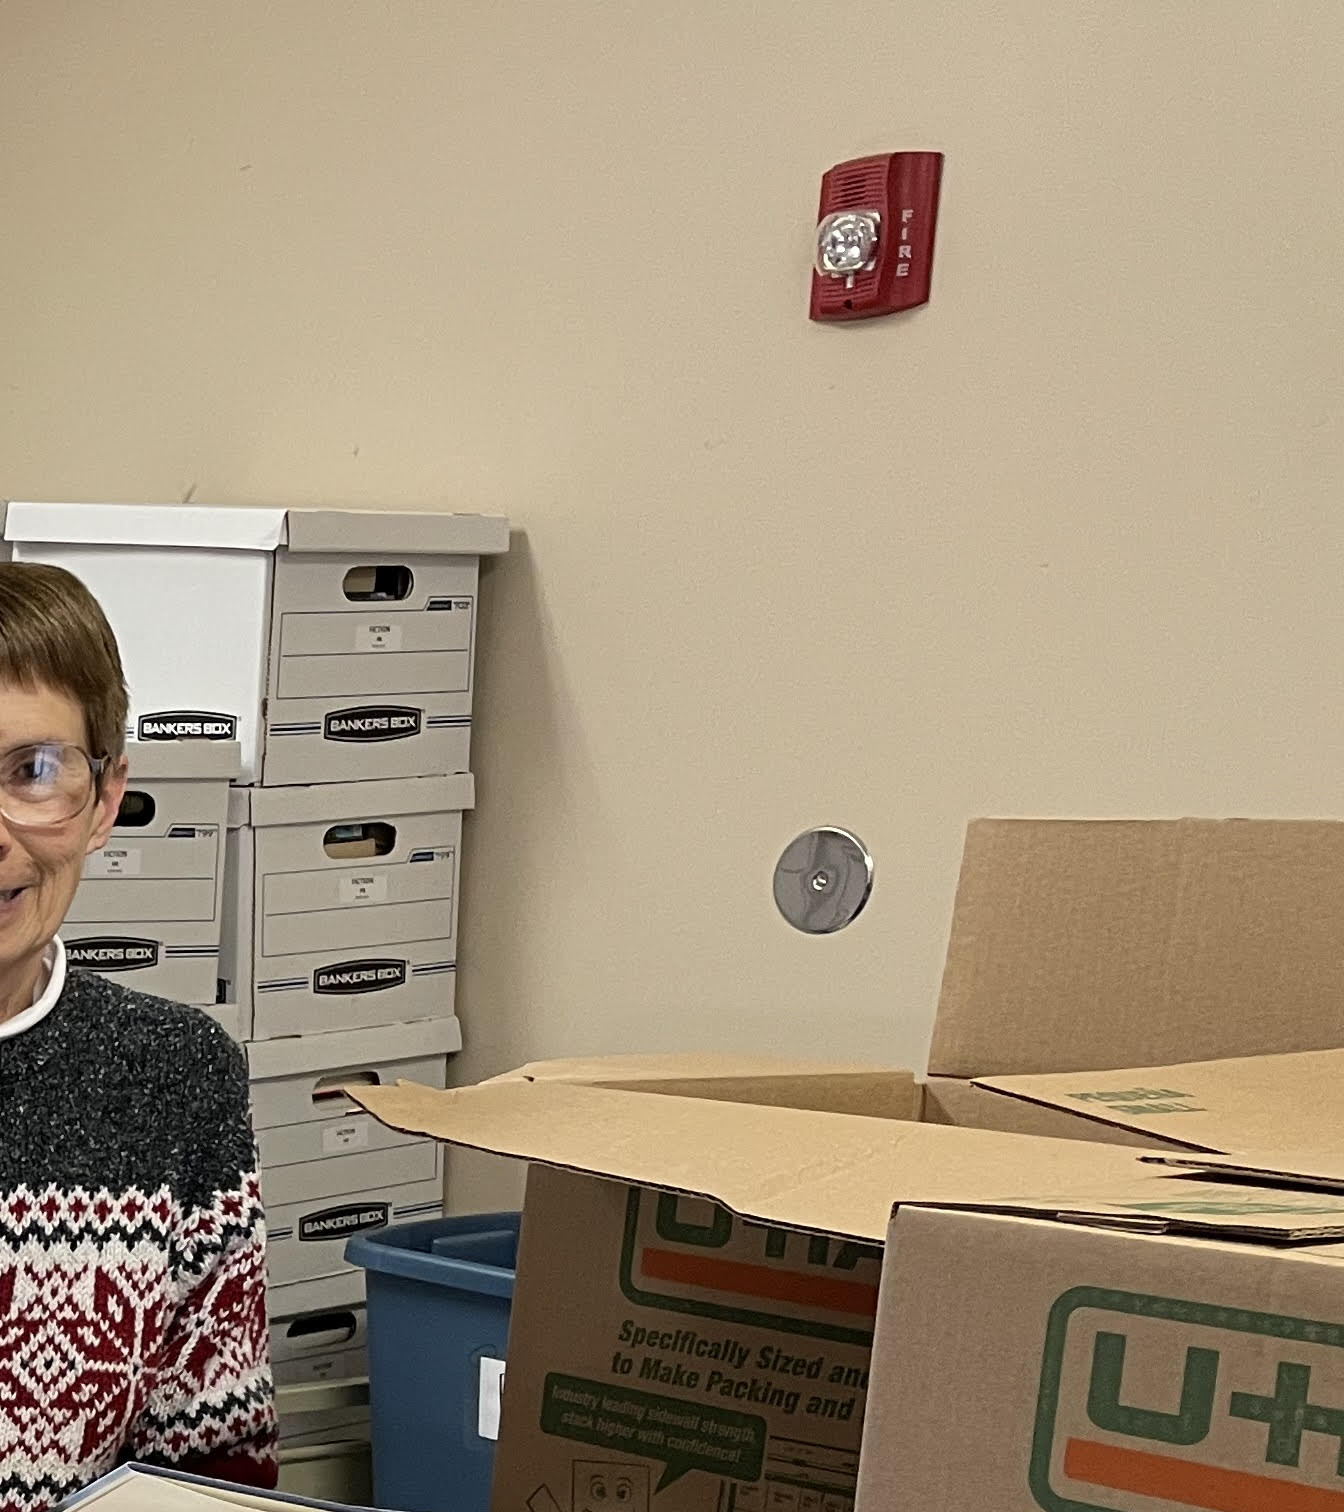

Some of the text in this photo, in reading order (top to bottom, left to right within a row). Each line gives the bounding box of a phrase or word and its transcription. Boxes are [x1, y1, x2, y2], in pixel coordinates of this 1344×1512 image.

[896, 209, 914, 276] FIRE
[144, 722, 231, 736] BANKERS BOX
[330, 717, 417, 732] BANKERS BOX
[125, 949, 153, 960] BOX
[319, 967, 401, 985] BANKERS BOX
[304, 1210, 384, 1233] BANKERS BOX
[618, 1319, 823, 1379] Specifically Sized
[612, 1352, 856, 1420] to Make Packing and
[562, 1412, 594, 1430] stack
[596, 1417, 636, 1440] higher
[637, 1427, 665, 1446] with
